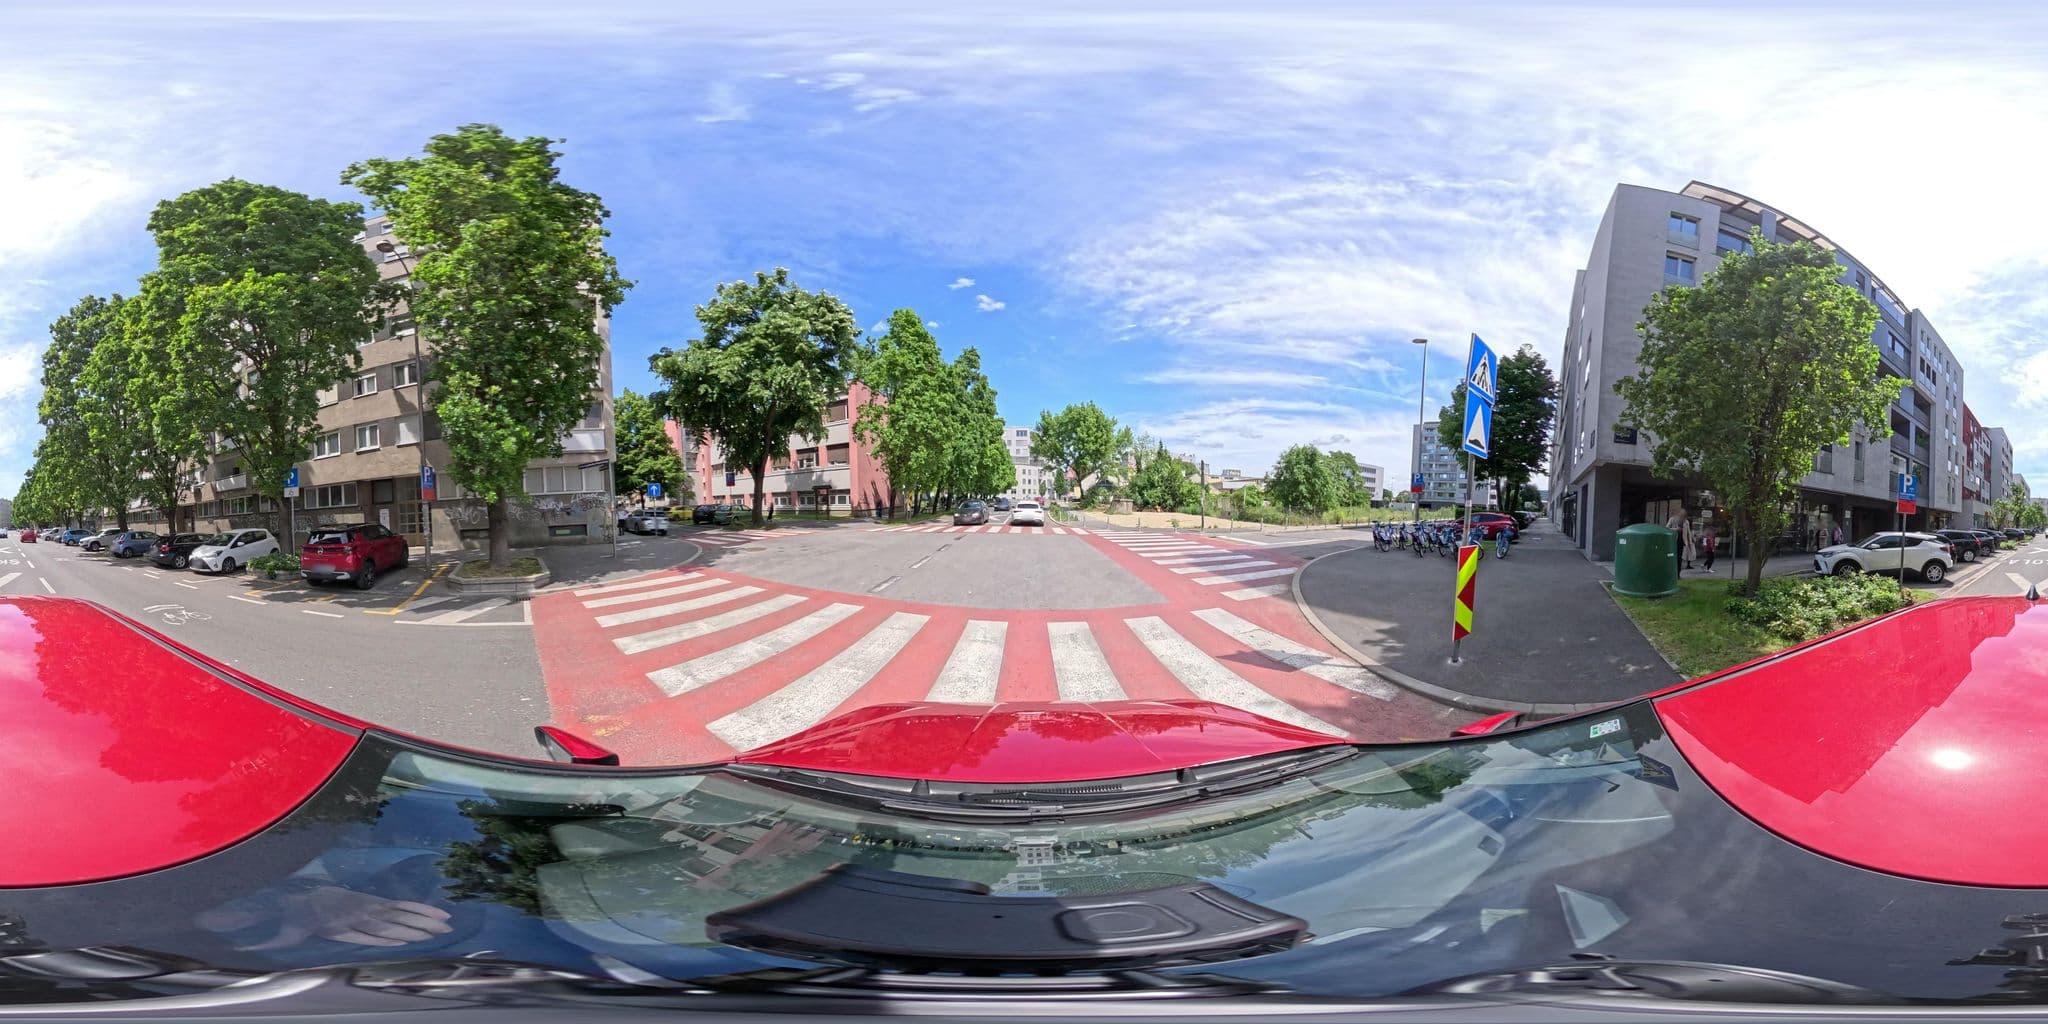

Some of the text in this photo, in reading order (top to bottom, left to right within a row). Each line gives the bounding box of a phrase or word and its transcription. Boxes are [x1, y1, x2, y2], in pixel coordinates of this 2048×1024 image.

[424, 466, 431, 482] P
[1414, 472, 1421, 482] P
[1903, 473, 1913, 493] P
